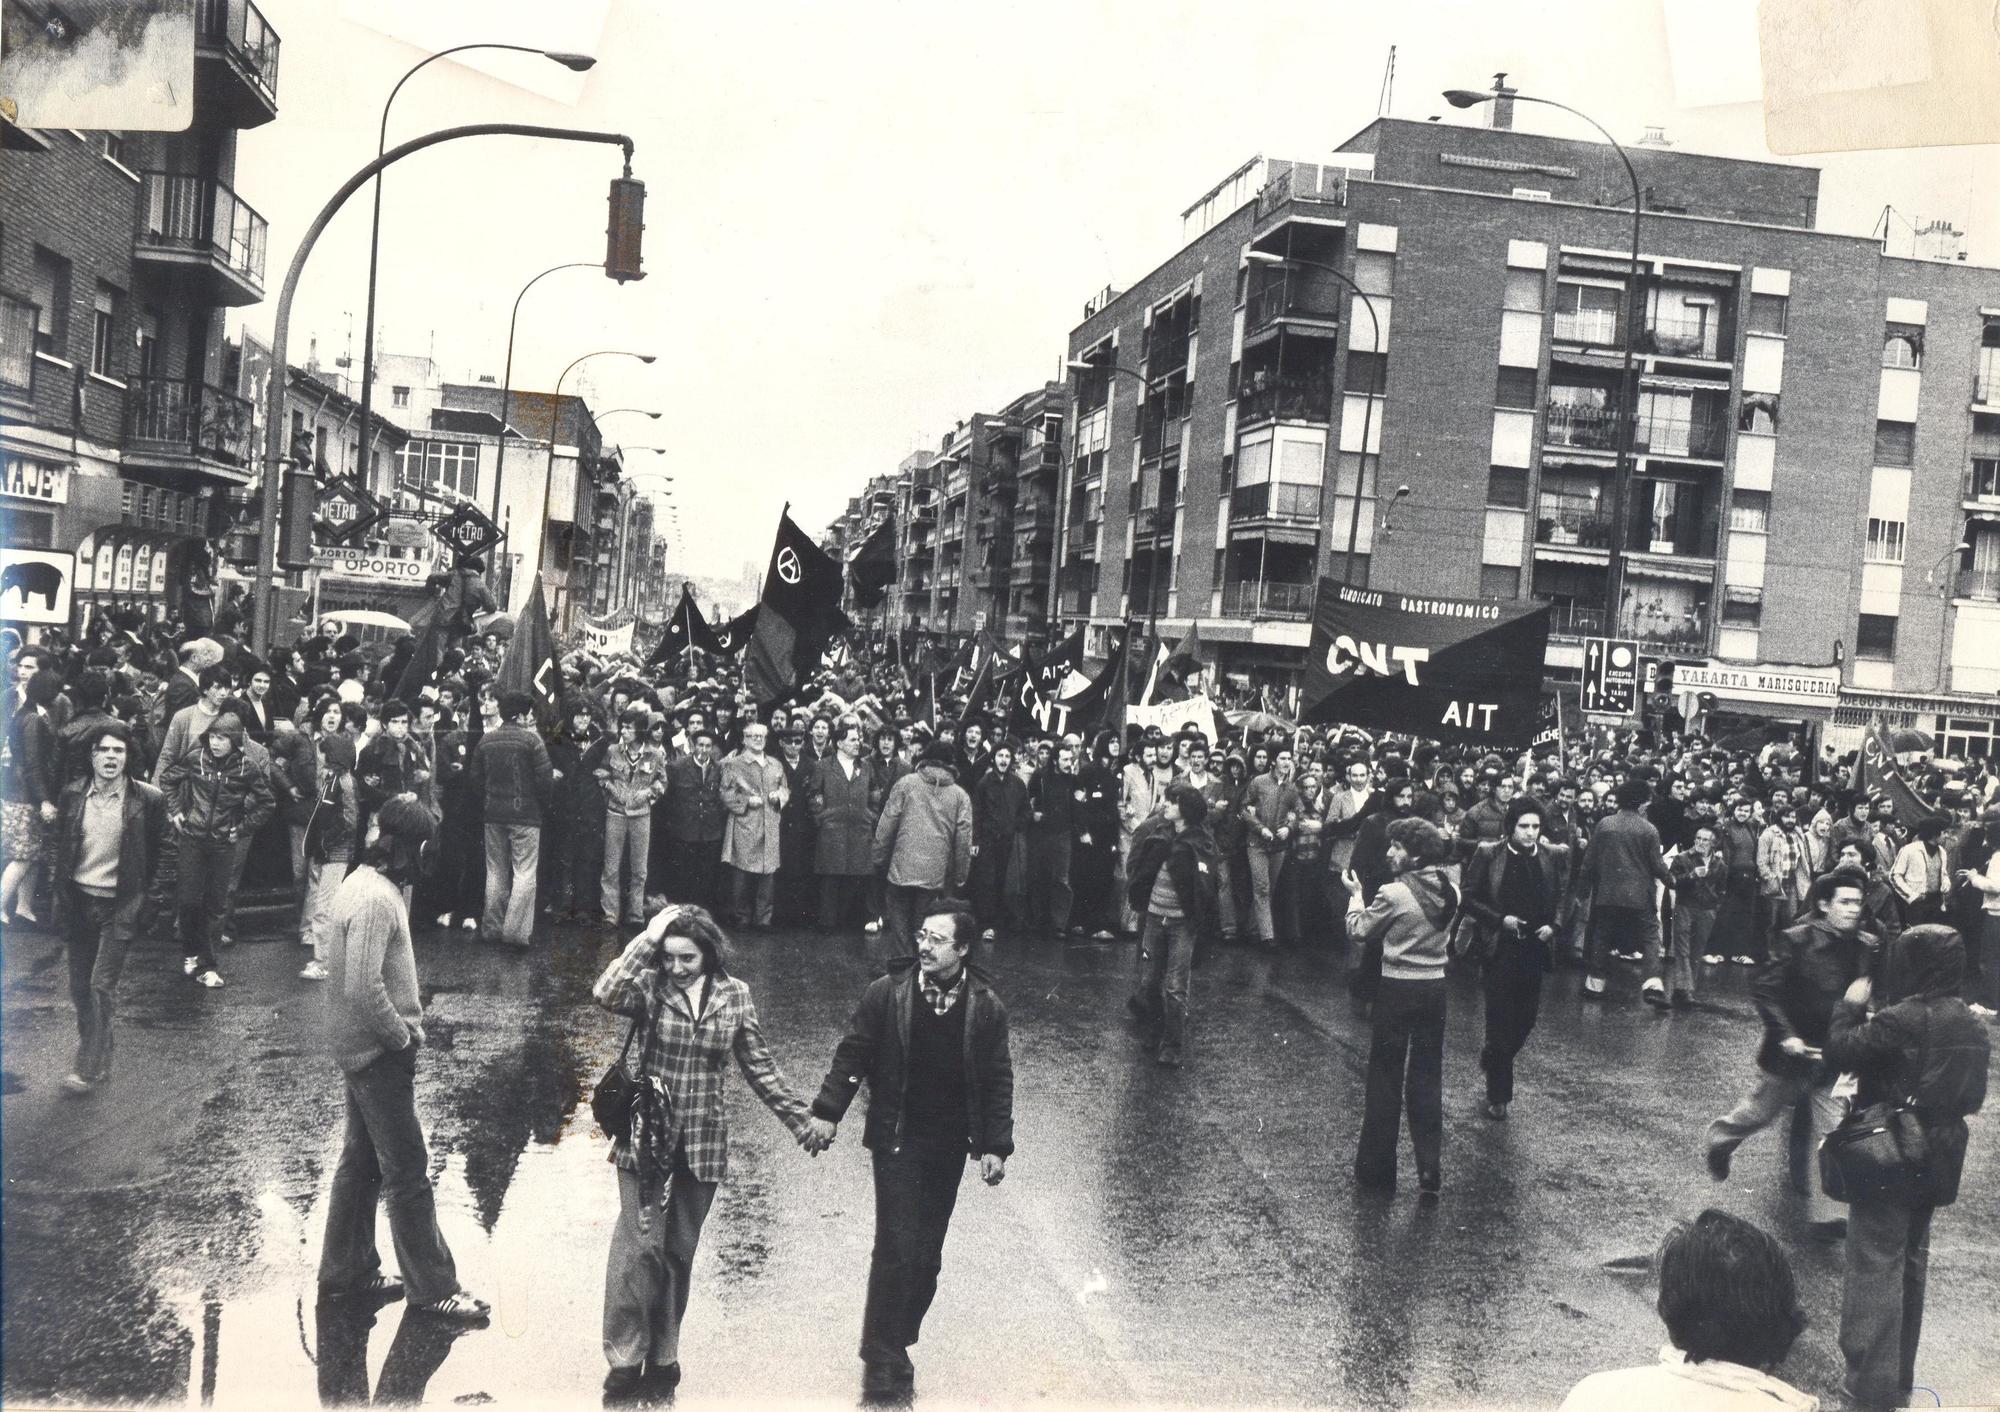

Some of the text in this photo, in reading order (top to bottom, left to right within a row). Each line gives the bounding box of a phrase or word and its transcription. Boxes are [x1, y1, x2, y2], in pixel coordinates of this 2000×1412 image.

[320, 502, 357, 520] METRO
[345, 560, 420, 576] OPORTO
[1340, 586, 1499, 619] SINDICATO GASTRONOMICO
[1326, 635, 1429, 686] CNT
[1605, 677, 1635, 685] AUTOBUSES
[1608, 670, 1632, 678] EXCEPTO
[1681, 669, 1836, 694] YAKARTA MARISQUERIA
[1840, 694, 1882, 708] JUEGOS
[1889, 697, 1972, 715] RECREATIVOS
[1441, 700, 1499, 731] AIT
